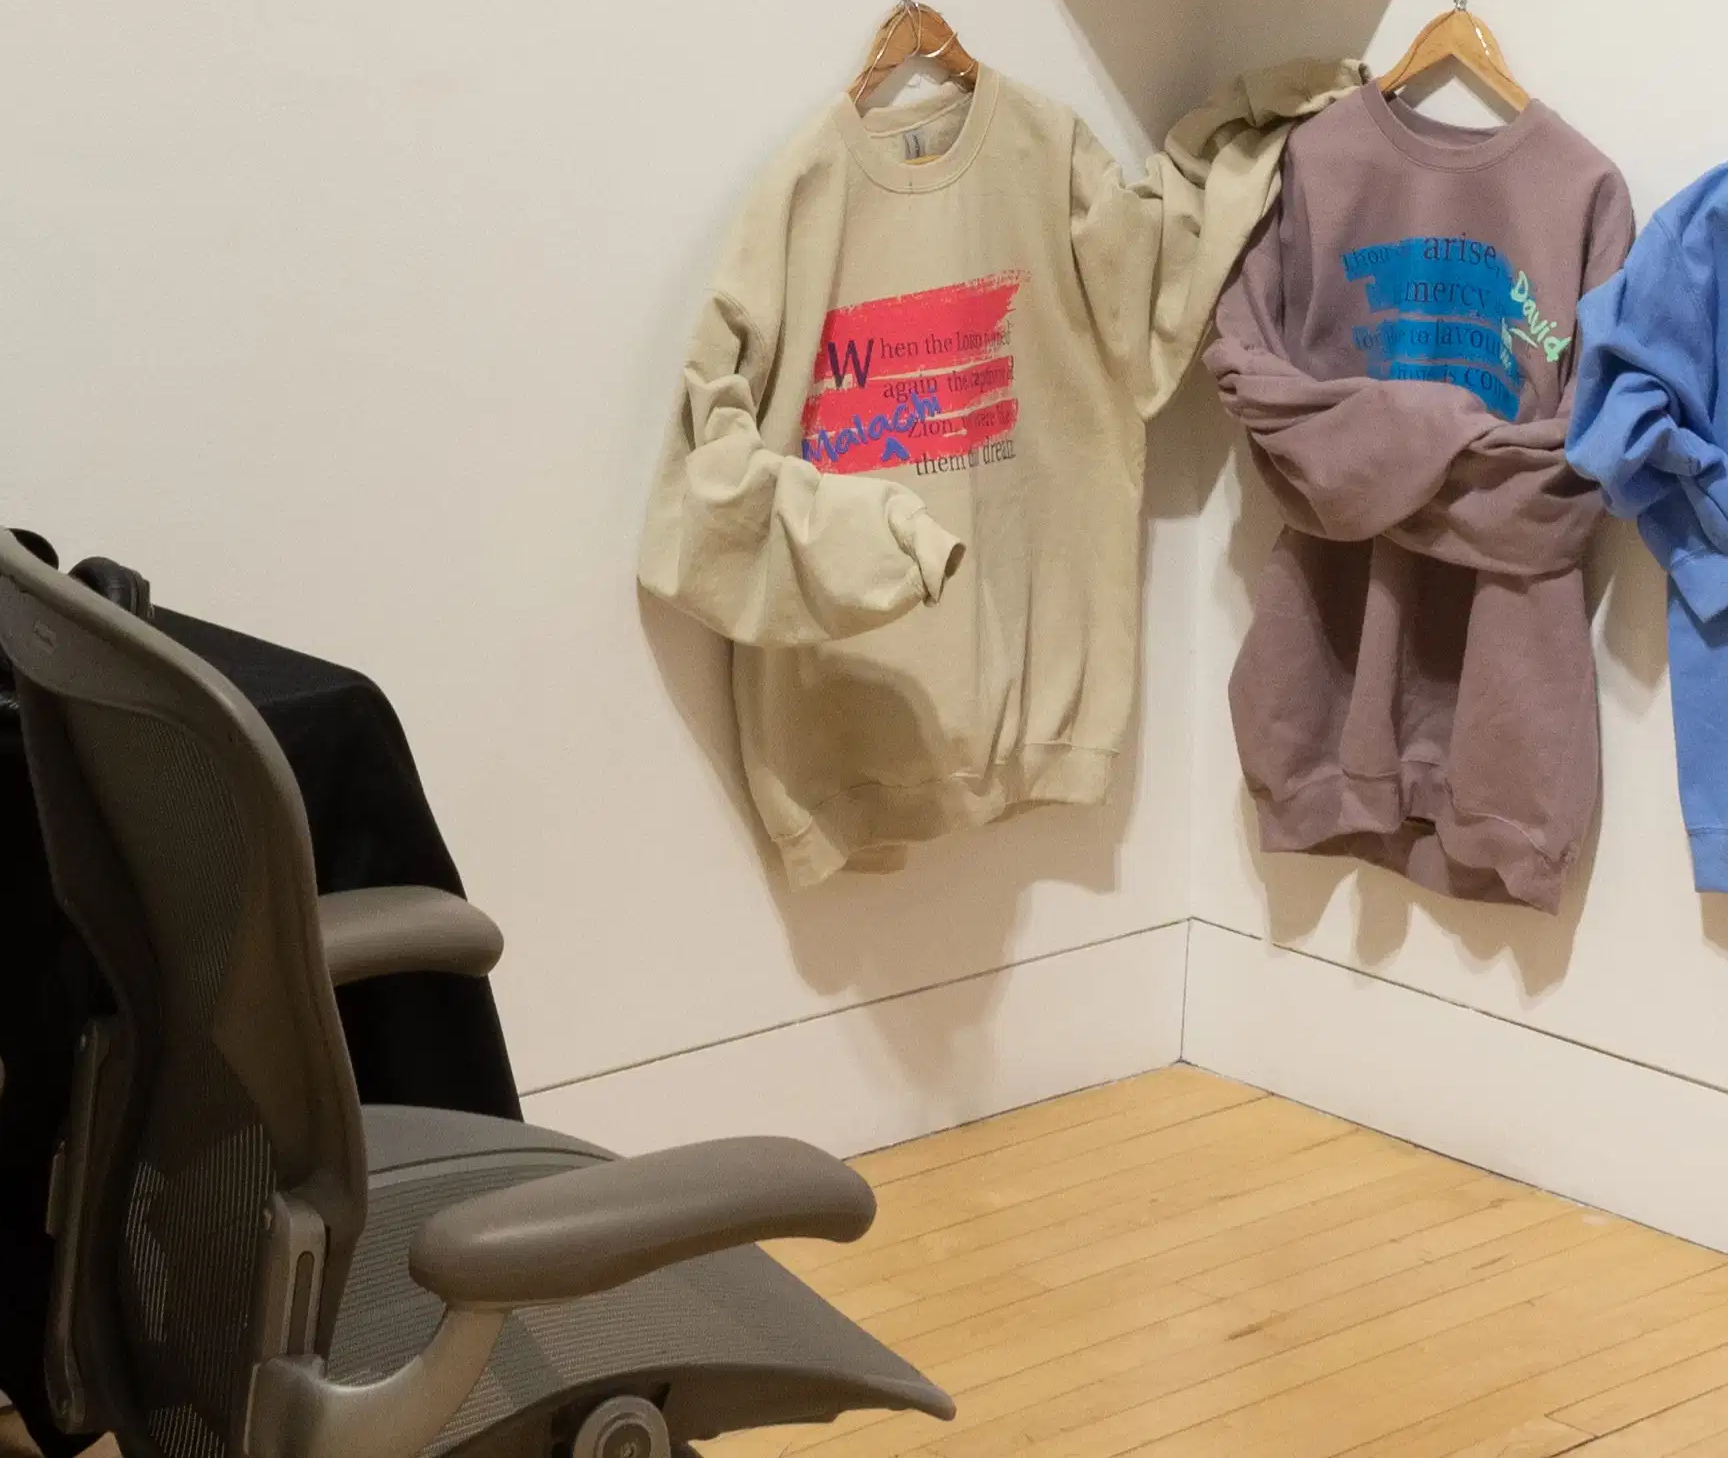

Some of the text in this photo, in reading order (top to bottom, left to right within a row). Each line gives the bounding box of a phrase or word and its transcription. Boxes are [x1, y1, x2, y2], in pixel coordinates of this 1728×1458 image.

[1423, 232, 1501, 278] arise,
[1403, 280, 1491, 310] mercy
[1511, 270, 1572, 363] David
[925, 333, 953, 355] the
[883, 373, 938, 403] again
[947, 370, 968, 393] the
[802, 387, 942, 463] Malachi
[916, 448, 966, 476] them
